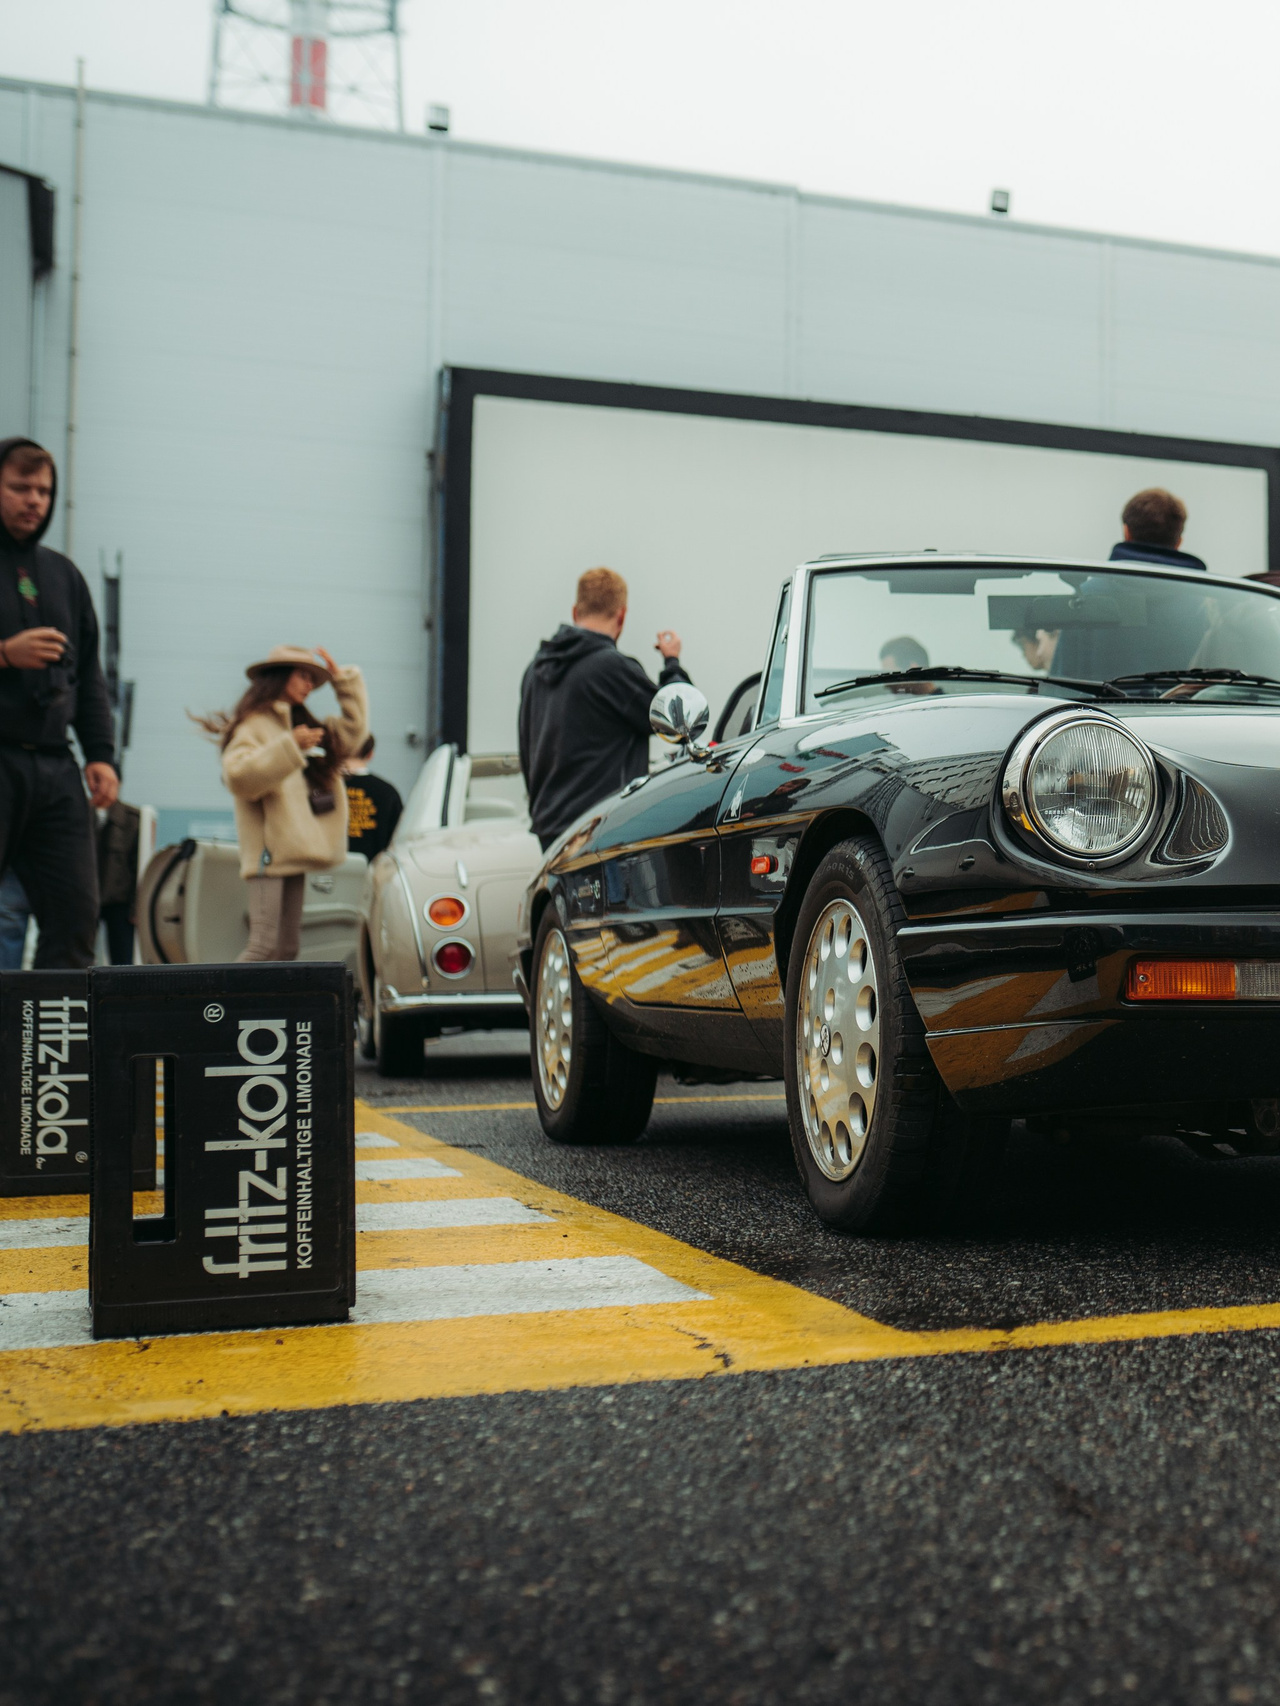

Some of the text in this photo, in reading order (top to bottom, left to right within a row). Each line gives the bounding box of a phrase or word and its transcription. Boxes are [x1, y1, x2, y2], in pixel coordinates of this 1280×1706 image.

[20, 1000, 34, 1155] KOFFEINHALTIGE LIMONADE
[36, 996, 89, 1155] fritz-kola
[202, 1018, 287, 1278] fritz-kola
[296, 1021, 312, 1269] KOFFEINHALTIGE LIMONADE
